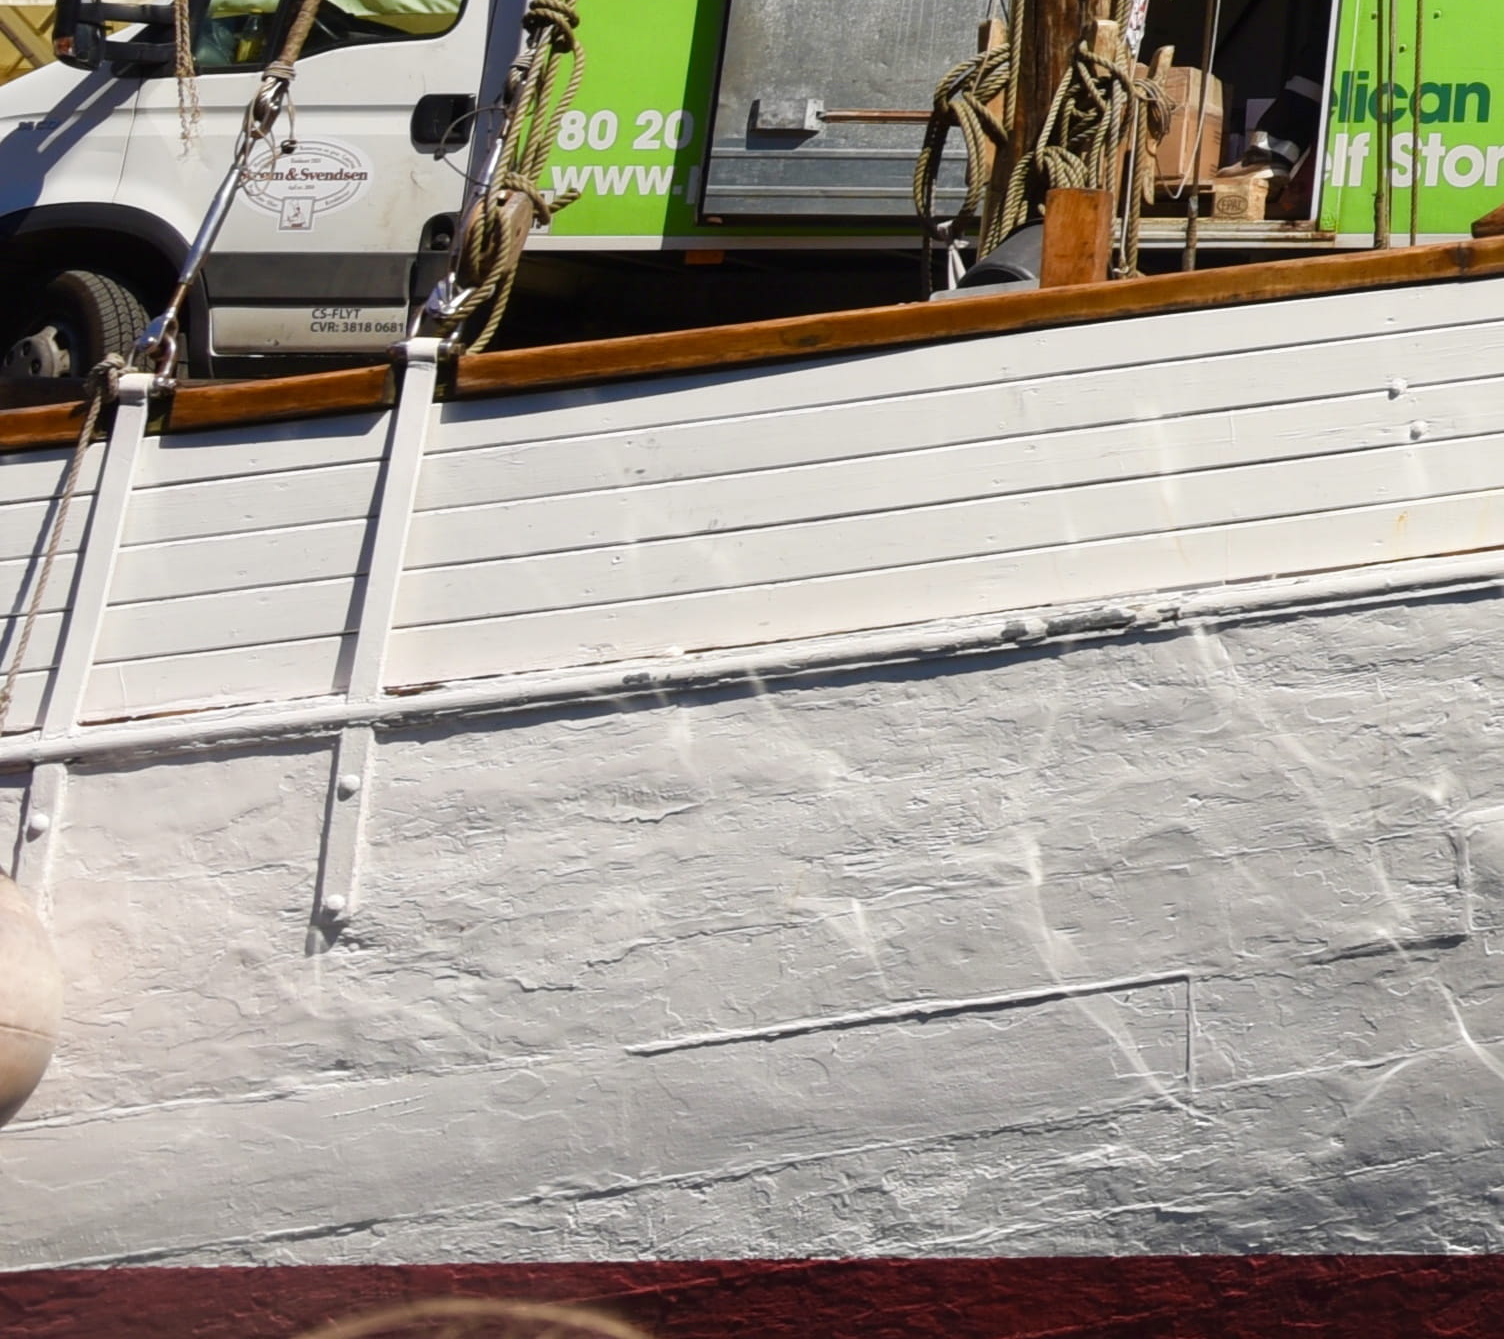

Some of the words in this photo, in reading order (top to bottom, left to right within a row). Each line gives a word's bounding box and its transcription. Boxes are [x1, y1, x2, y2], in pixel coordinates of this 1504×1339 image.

[556, 109, 618, 151] 80
[632, 109, 694, 151] 20
[1324, 132, 1371, 187] lf
[285, 167, 299, 181] &
[300, 167, 368, 182] Svendsen
[311, 308, 361, 320] CS-FLYT
[310, 321, 339, 333] CVR:
[341, 321, 372, 333] 3818
